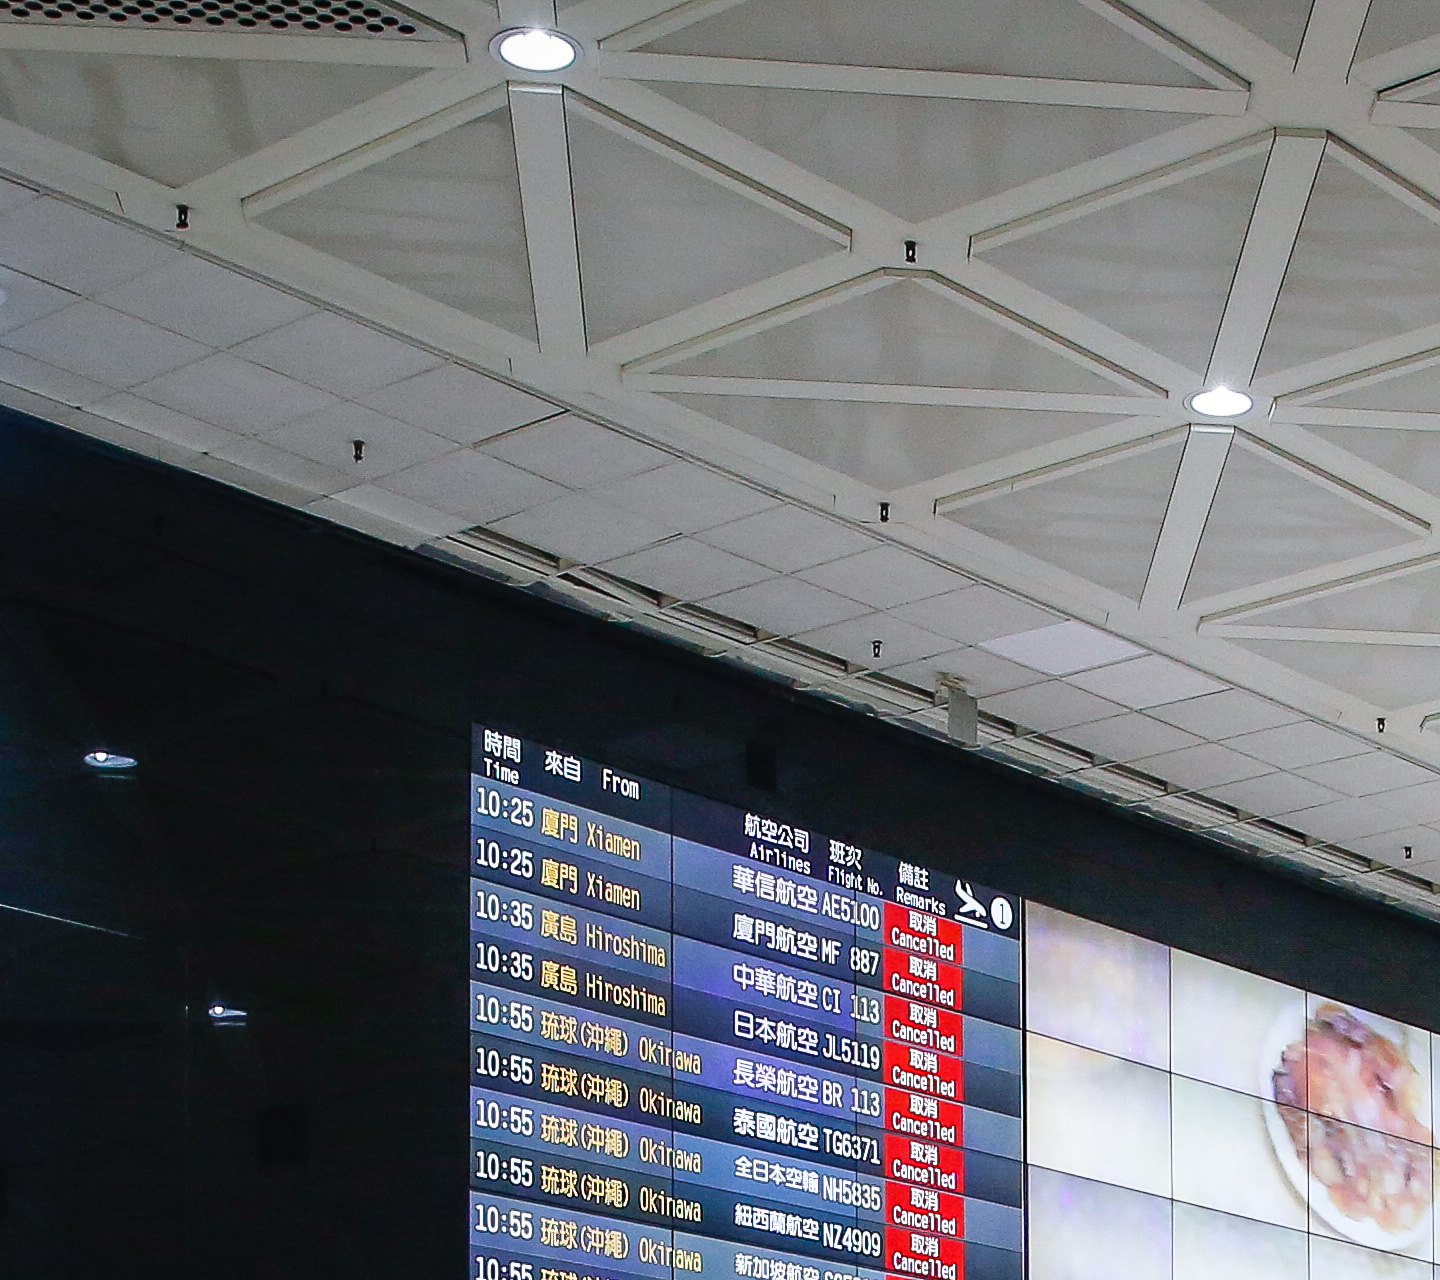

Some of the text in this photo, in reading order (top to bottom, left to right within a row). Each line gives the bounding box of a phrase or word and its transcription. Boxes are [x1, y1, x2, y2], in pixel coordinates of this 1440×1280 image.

[484, 729, 521, 763] 時間
[483, 757, 520, 785] Time
[544, 750, 640, 800] 來自 From
[744, 812, 809, 854] 航空公司
[477, 787, 880, 930] 10:25 廈門 Xiamen 華信航空 AE5100
[749, 841, 811, 875] Airlines
[829, 839, 862, 871] 班次
[828, 865, 863, 891] Flight
[898, 861, 929, 891] 備註
[476, 838, 879, 975] 10:25 廈門 Xiamen 廈門航空 MF 887
[896, 886, 946, 916] Remarks
[908, 910, 937, 937] 取消
[476, 891, 533, 930] 10:35
[586, 922, 666, 968] Hiroshima
[733, 963, 819, 1009] 中華航空
[822, 986, 841, 1014] CI
[850, 994, 880, 1024] 113
[891, 926, 954, 961] Cancelled
[476, 942, 533, 981] 10:35
[586, 972, 666, 1017] Hiroshima
[734, 1010, 819, 1056] 日本航空
[822, 1033, 880, 1070] JL5119
[476, 994, 533, 1032] 10:55
[822, 1079, 843, 1108] BR
[851, 1087, 880, 1117] 113
[476, 1047, 533, 1085] 10:55
[733, 1107, 819, 1151] 泰國航空
[822, 1127, 881, 1165] TG6371
[476, 1099, 533, 1136] 10:55
[823, 1175, 881, 1211] NH5835
[910, 1141, 938, 1165] 取消
[893, 1158, 956, 1190] Cancelled
